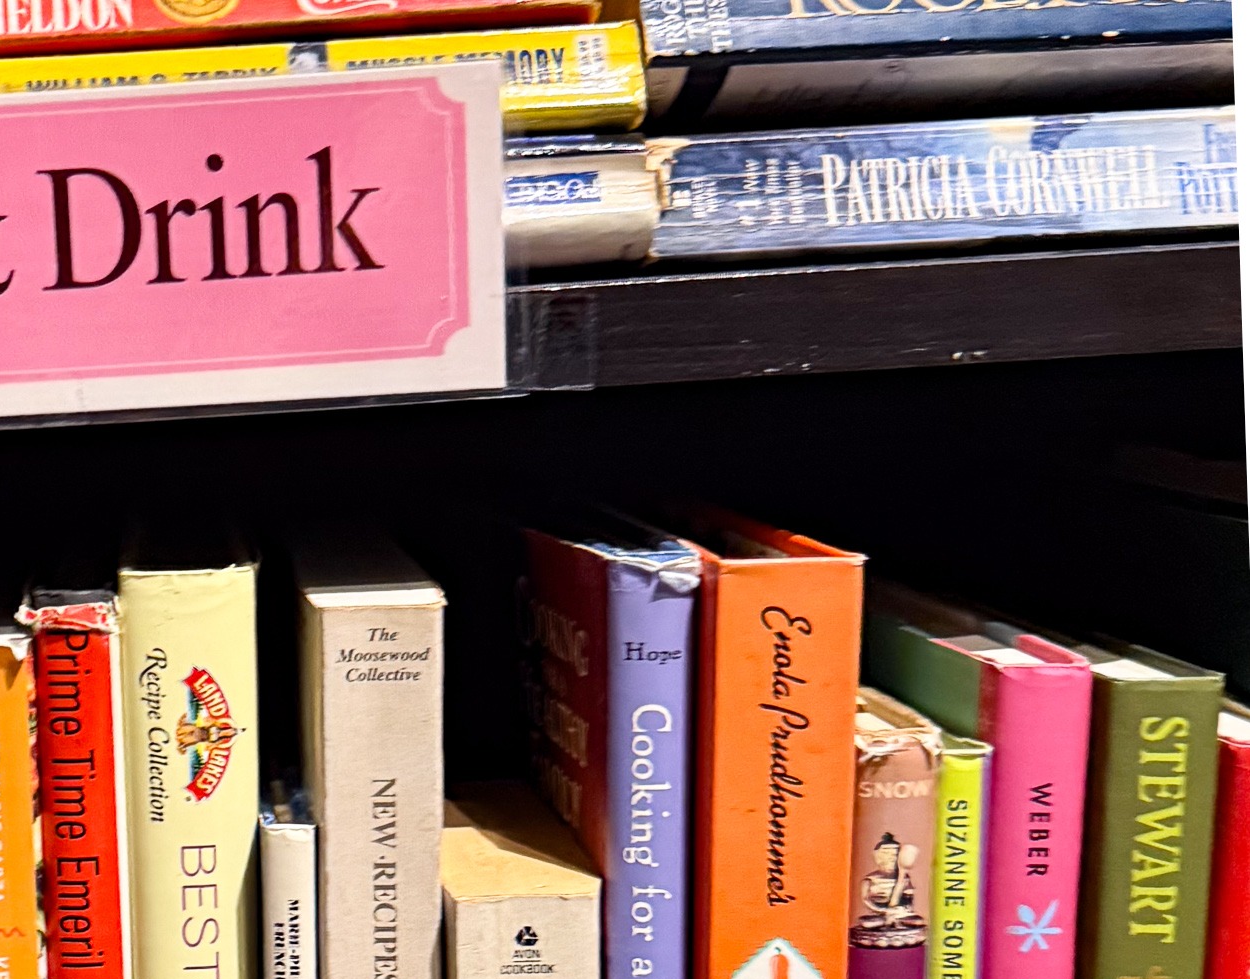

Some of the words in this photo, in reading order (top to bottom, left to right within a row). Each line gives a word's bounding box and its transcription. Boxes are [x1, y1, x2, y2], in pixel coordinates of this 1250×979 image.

[37, 146, 386, 291] Drink
[822, 154, 981, 226] PATRICIA
[986, 145, 1172, 218] CORNWELL
[336, 647, 431, 664] Moosewood
[345, 667, 422, 683] Collective
[367, 627, 400, 642] The
[622, 640, 683, 666] Hope
[759, 604, 813, 701] Enola
[47, 628, 92, 737] Prime
[138, 647, 168, 720] Recipe
[51, 749, 97, 840] Time
[143, 726, 170, 824] Collection
[370, 777, 399, 849] NEW
[622, 703, 673, 869] Cooking
[757, 702, 811, 908] Prudhomme's
[858, 781, 928, 799] SNOW
[942, 799, 969, 908] SUZANNE
[1025, 782, 1053, 877] WEBER
[1128, 715, 1190, 944] STEWART
[54, 855, 105, 971] Emeril
[631, 885, 673, 943] for
[629, 957, 654, 978] a
